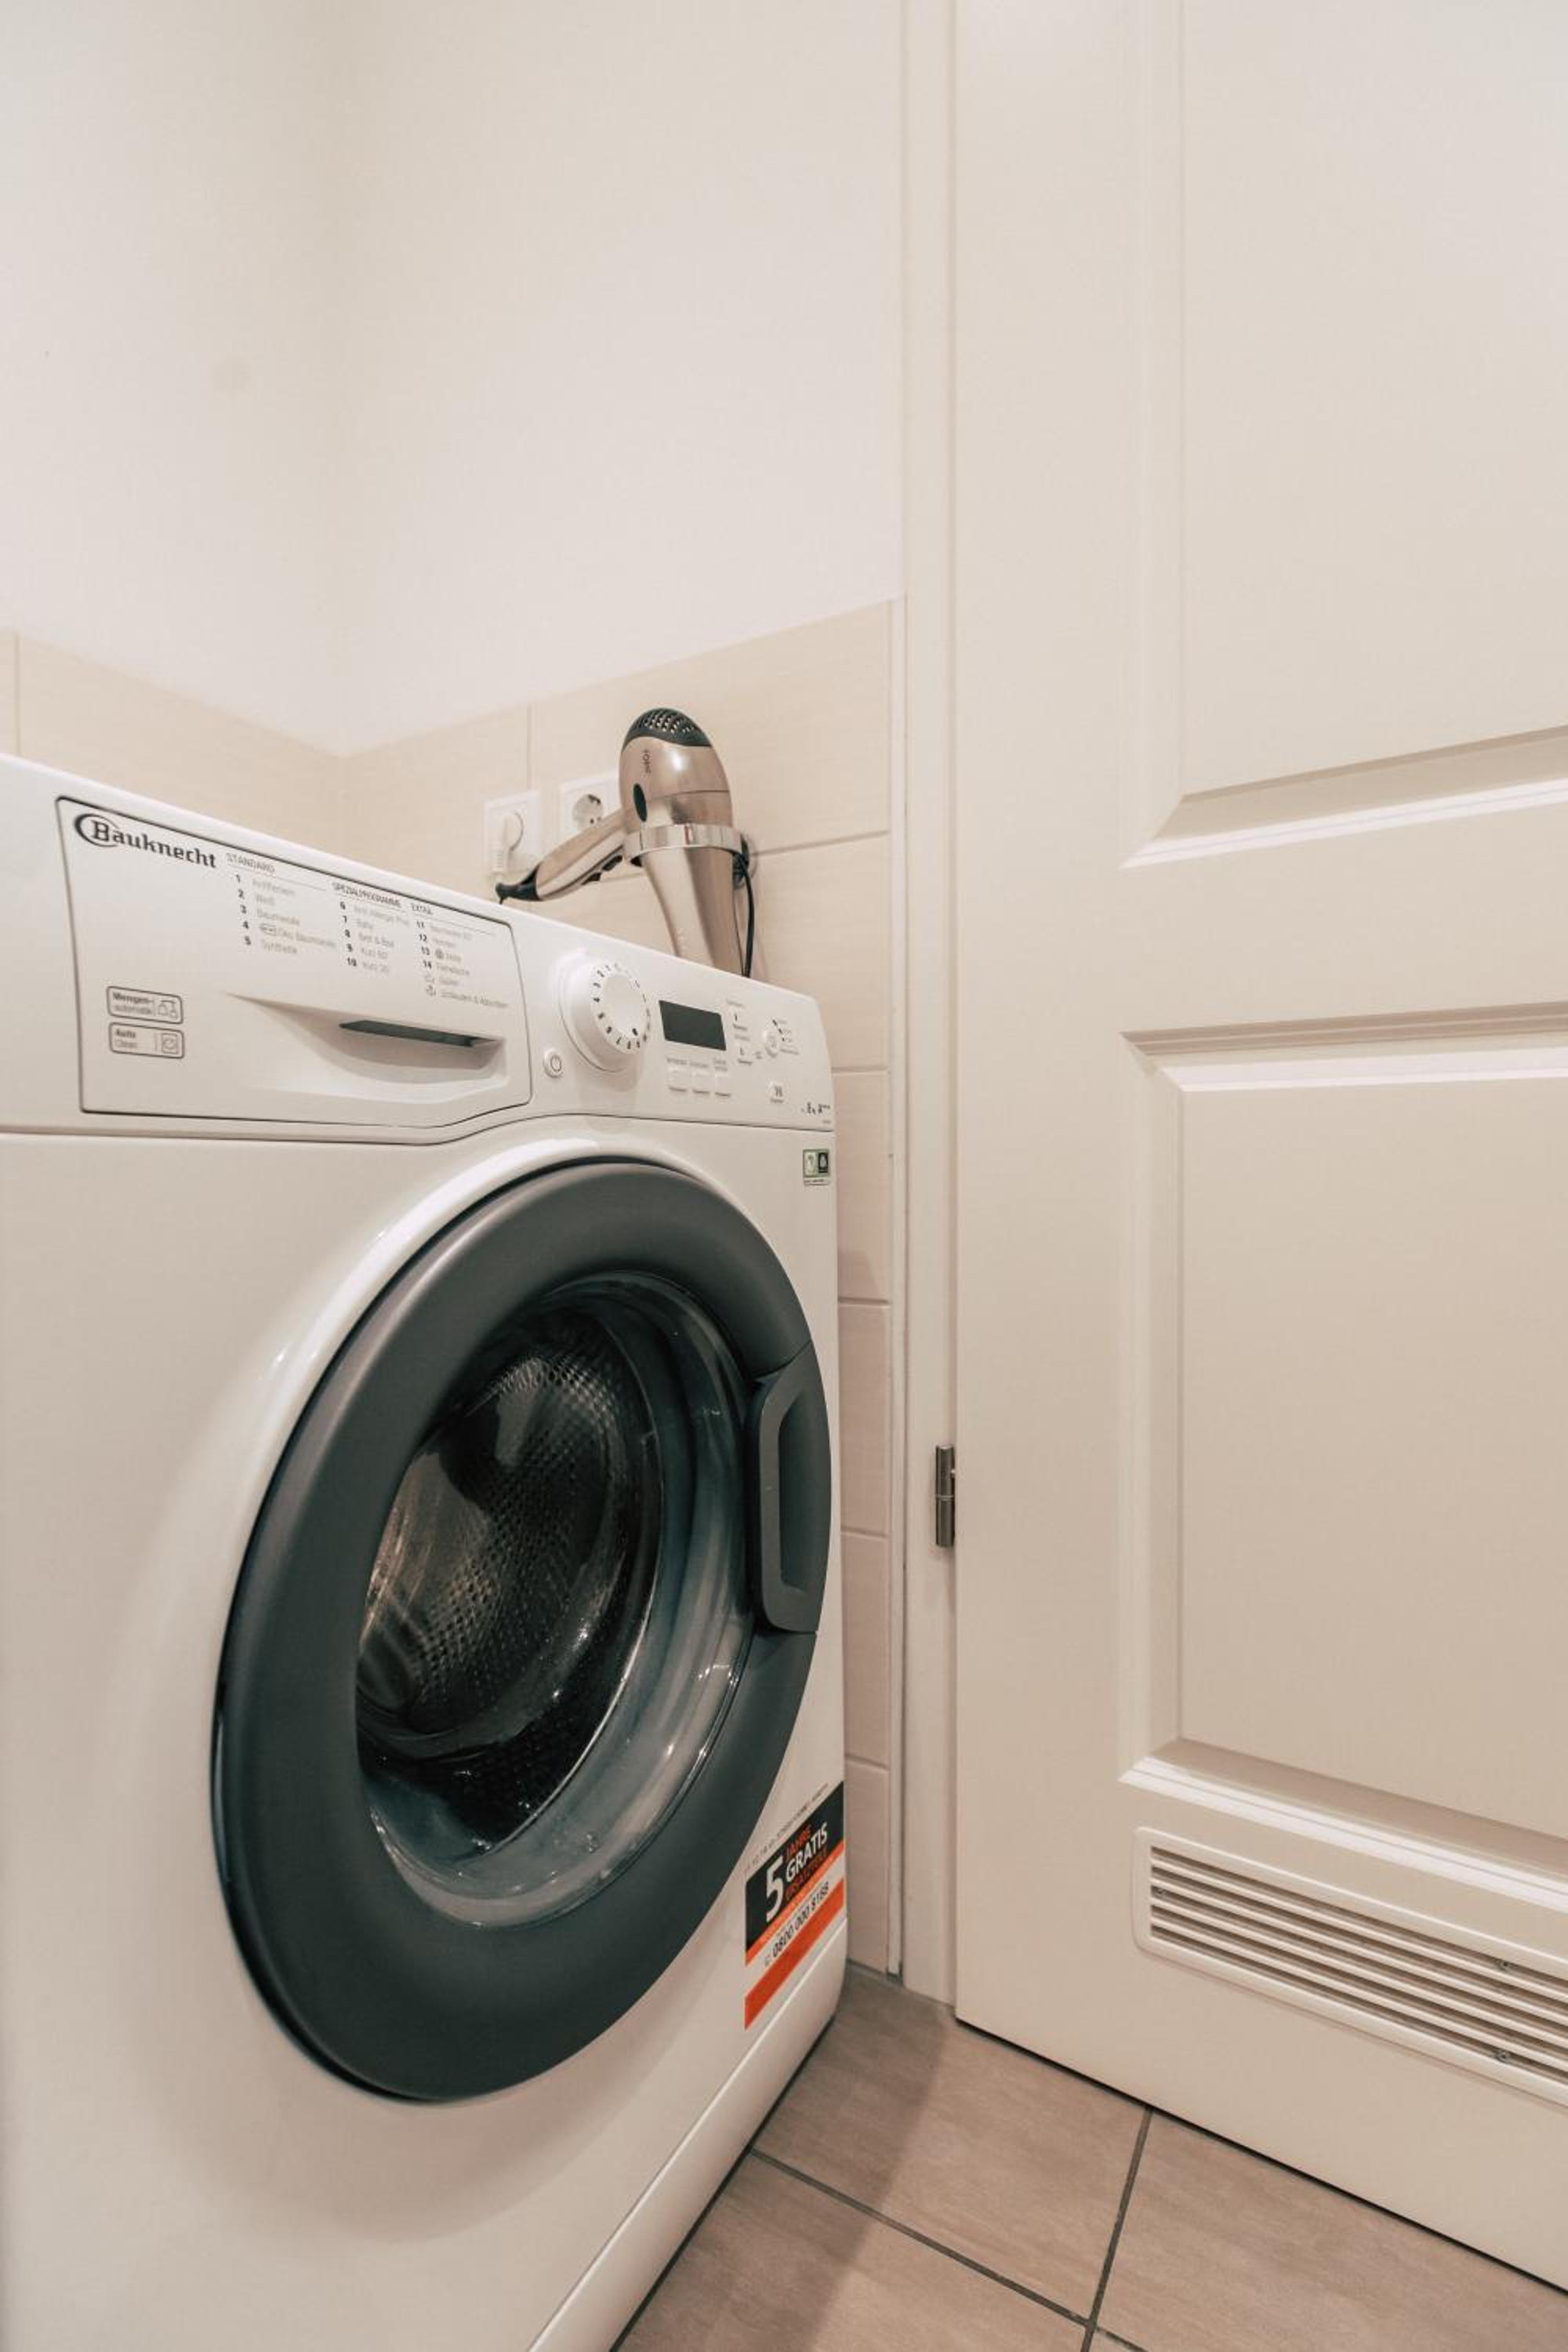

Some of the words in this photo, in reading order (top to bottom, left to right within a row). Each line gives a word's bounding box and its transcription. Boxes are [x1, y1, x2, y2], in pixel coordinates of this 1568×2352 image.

[86, 818, 216, 868] Bauknecht
[225, 851, 276, 873] STANDARD
[115, 1028, 136, 1039] Auto
[786, 1824, 812, 1864] JAHRE
[786, 1821, 828, 1883] GRATIS
[766, 1855, 783, 1923] 5
[772, 1923, 794, 1958] 0800
[795, 1904, 811, 1932] 000
